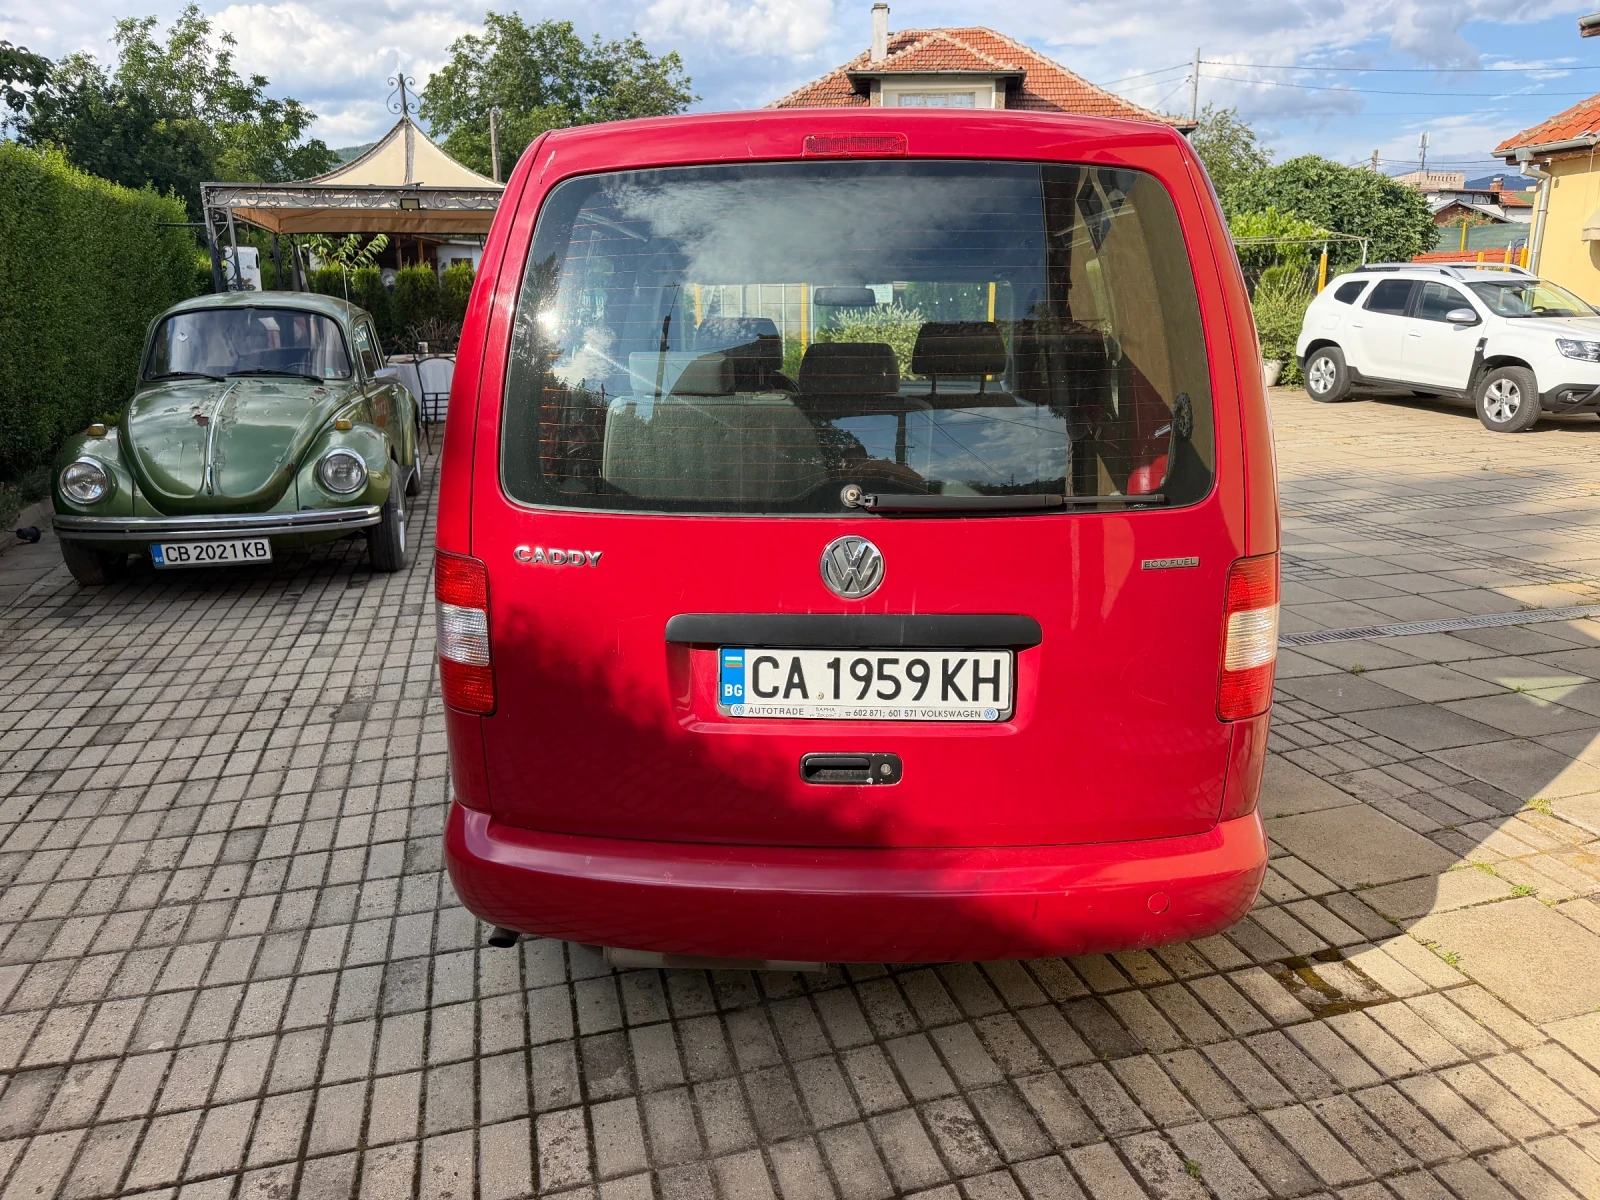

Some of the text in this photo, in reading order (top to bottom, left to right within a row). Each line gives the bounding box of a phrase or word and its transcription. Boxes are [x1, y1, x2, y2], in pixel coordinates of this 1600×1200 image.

[165, 542, 267, 562] CB 2021 KB
[514, 545, 602, 567] CADDY
[1170, 558, 1196, 566] FUEL
[752, 656, 1000, 702] CA 1959 KH
[724, 684, 743, 697] BG
[748, 707, 981, 718] AUTOTRADE 602 871; 601 571 VOLKSWAGEN
